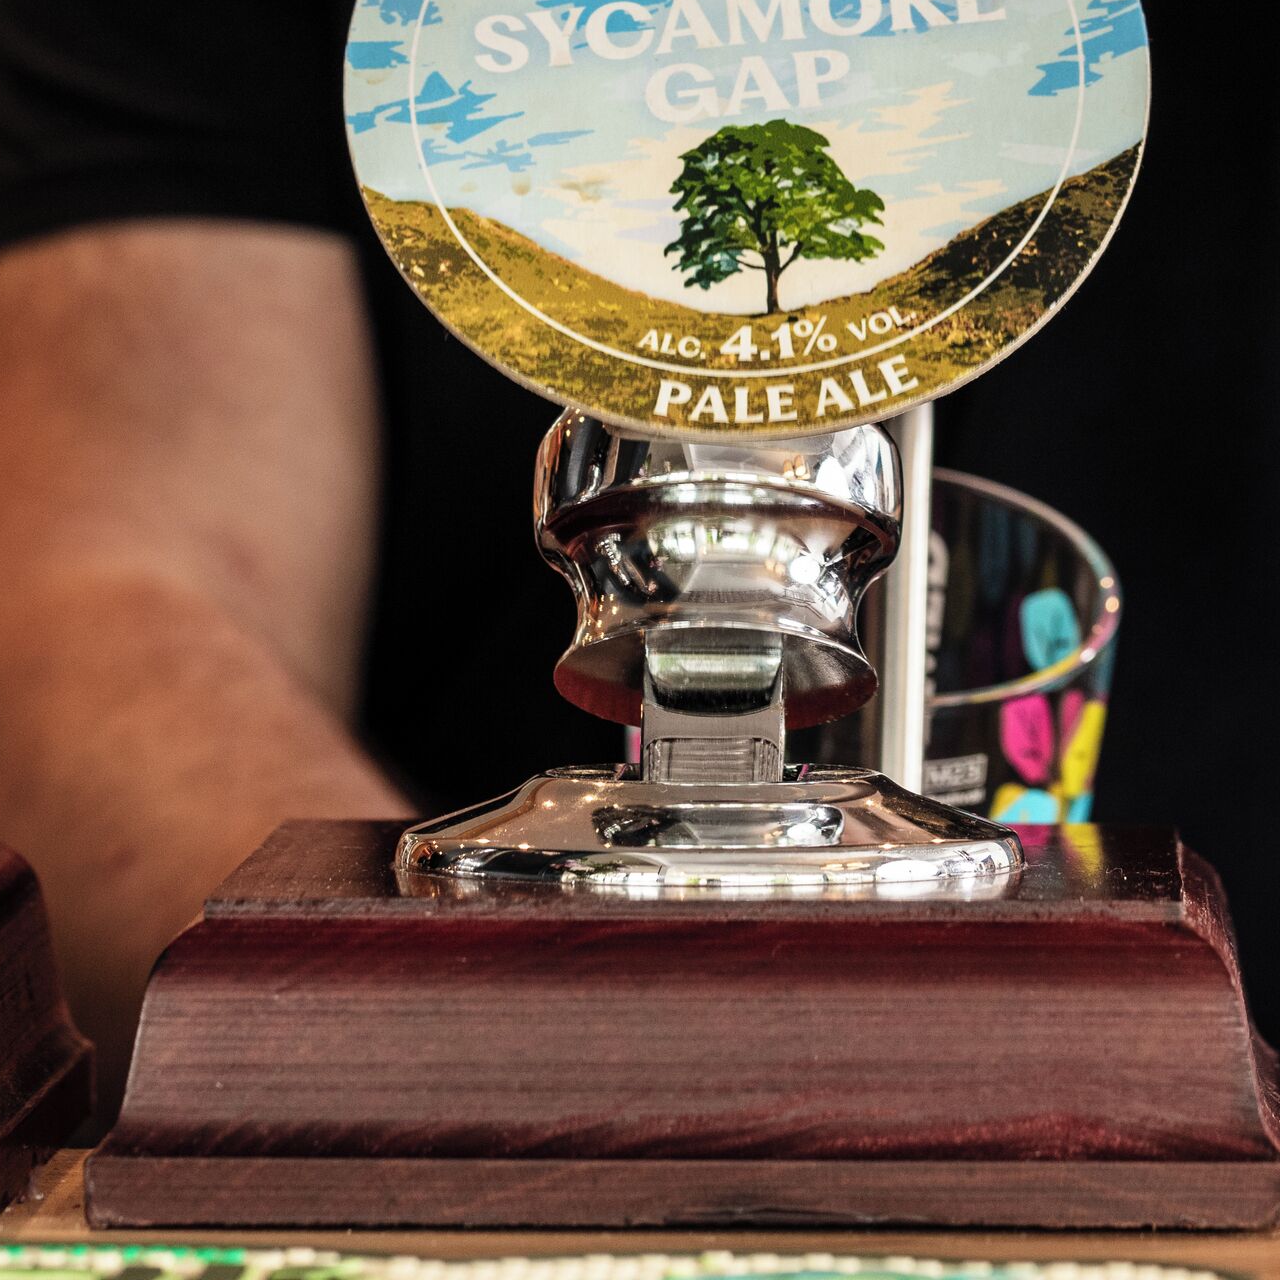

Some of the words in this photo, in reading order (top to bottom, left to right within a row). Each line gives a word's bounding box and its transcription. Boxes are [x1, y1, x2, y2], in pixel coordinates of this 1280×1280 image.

[645, 48, 851, 124] GAP
[637, 328, 706, 360] ALC.
[719, 315, 838, 363] 4.1%
[847, 305, 918, 342] VOL.
[652, 377, 799, 424] PALE
[816, 353, 919, 417] ALE
